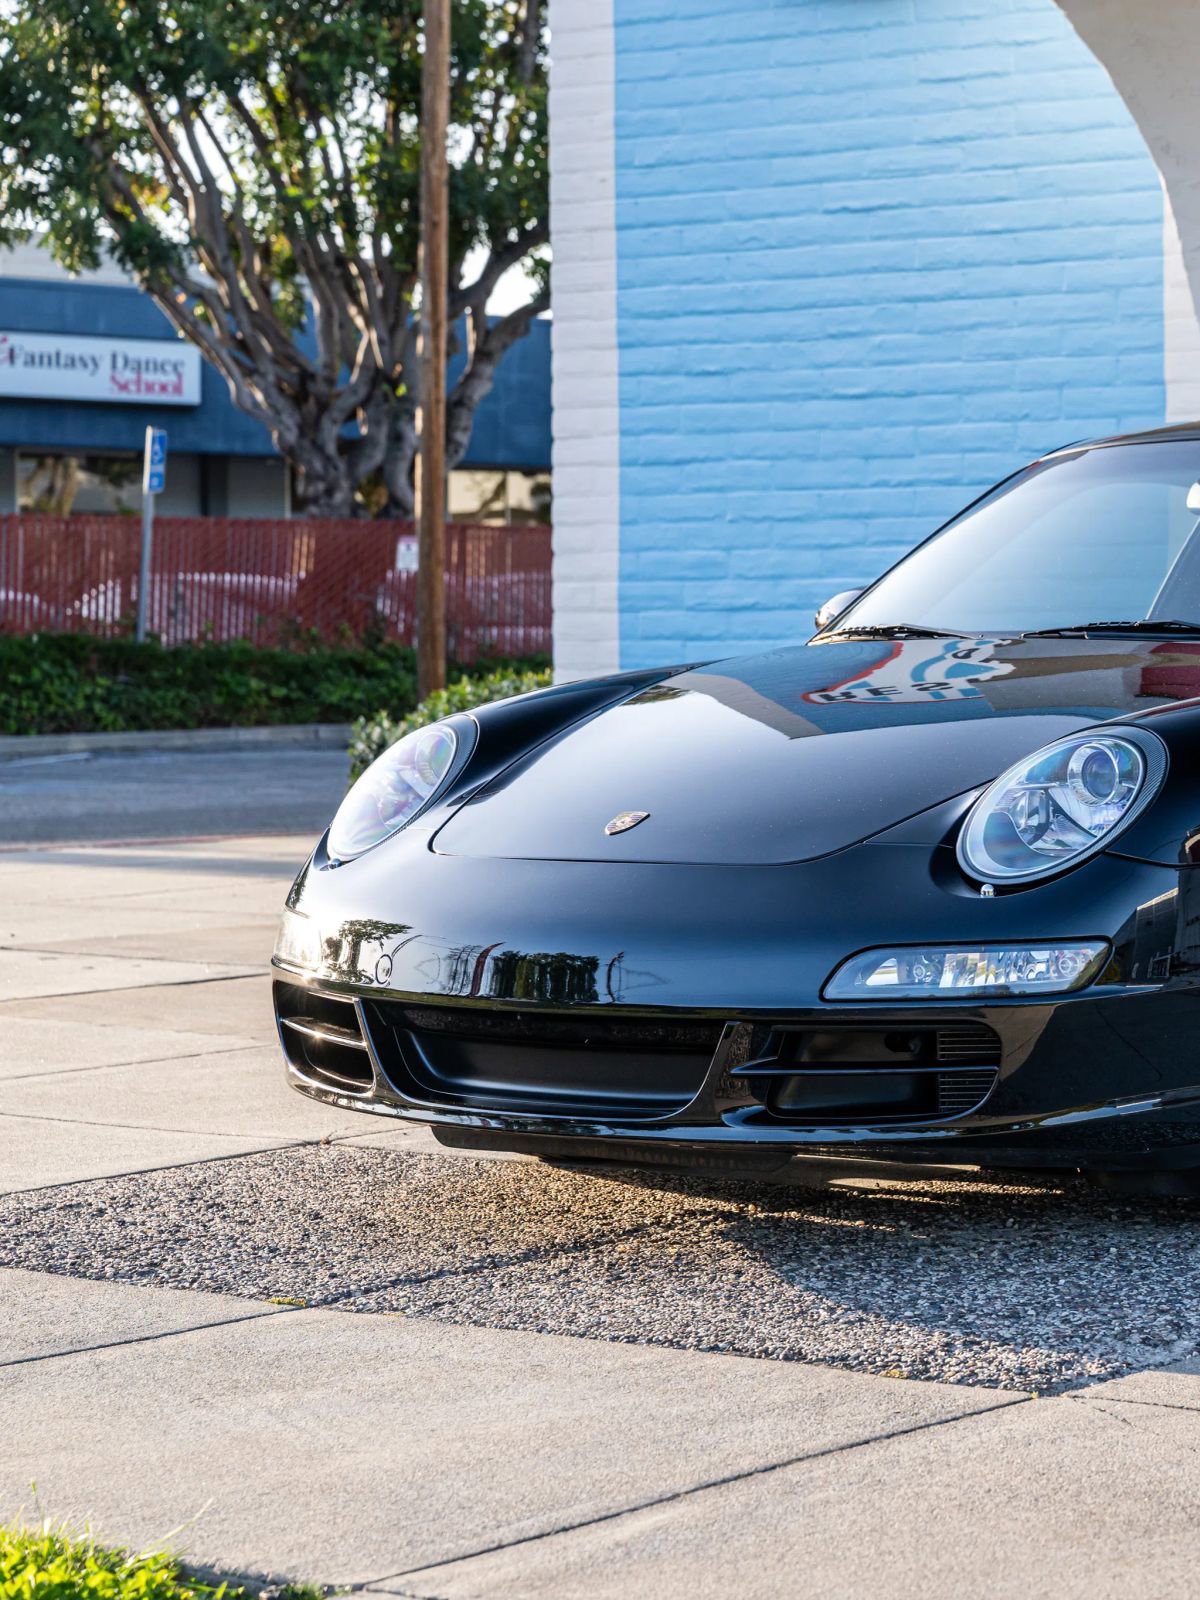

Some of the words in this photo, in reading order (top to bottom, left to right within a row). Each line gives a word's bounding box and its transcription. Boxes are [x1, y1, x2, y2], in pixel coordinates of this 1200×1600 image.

[9, 344, 100, 375] Fantasy
[111, 351, 184, 375] Dance
[110, 371, 183, 395] School
